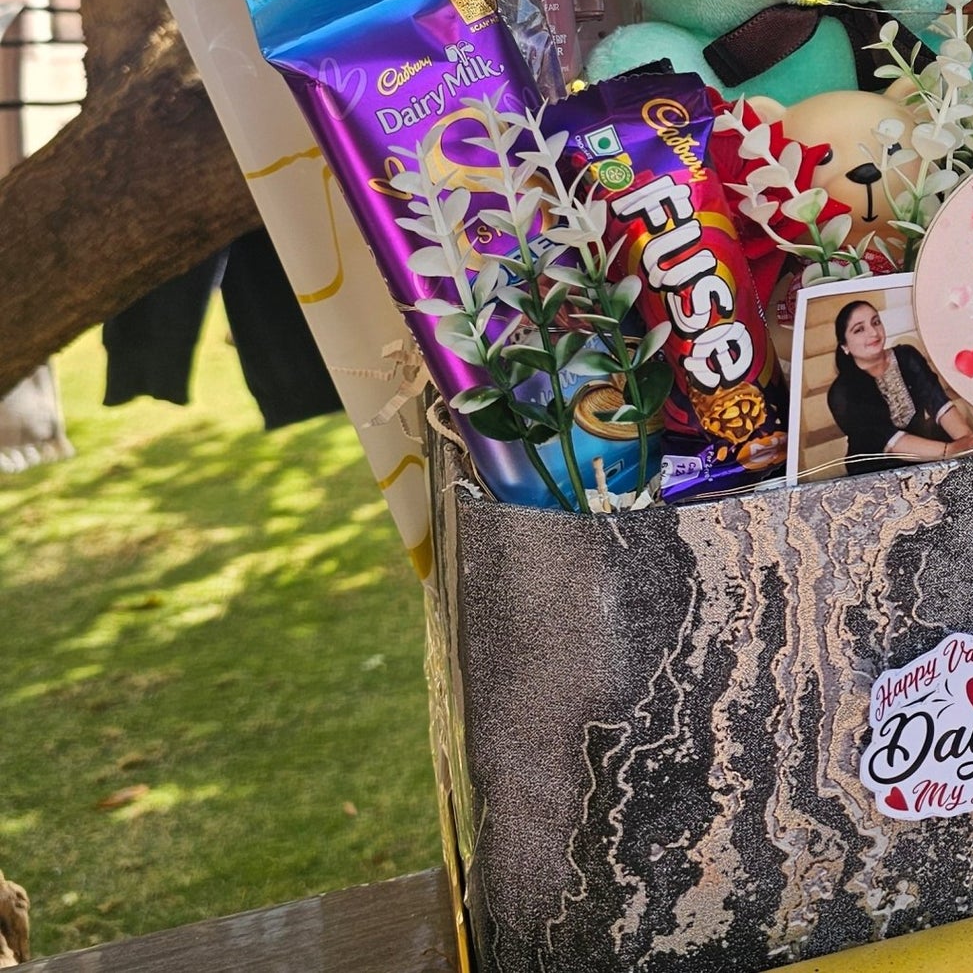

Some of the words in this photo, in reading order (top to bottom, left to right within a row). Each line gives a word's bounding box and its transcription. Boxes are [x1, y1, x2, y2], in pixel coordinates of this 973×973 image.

[375, 83, 446, 135] Dairy
[443, 54, 505, 97] Milk
[376, 55, 433, 96] Cadbury
[641, 97, 708, 183] Cadbury
[874, 657, 942, 722] Happy
[912, 779, 967, 813] My
